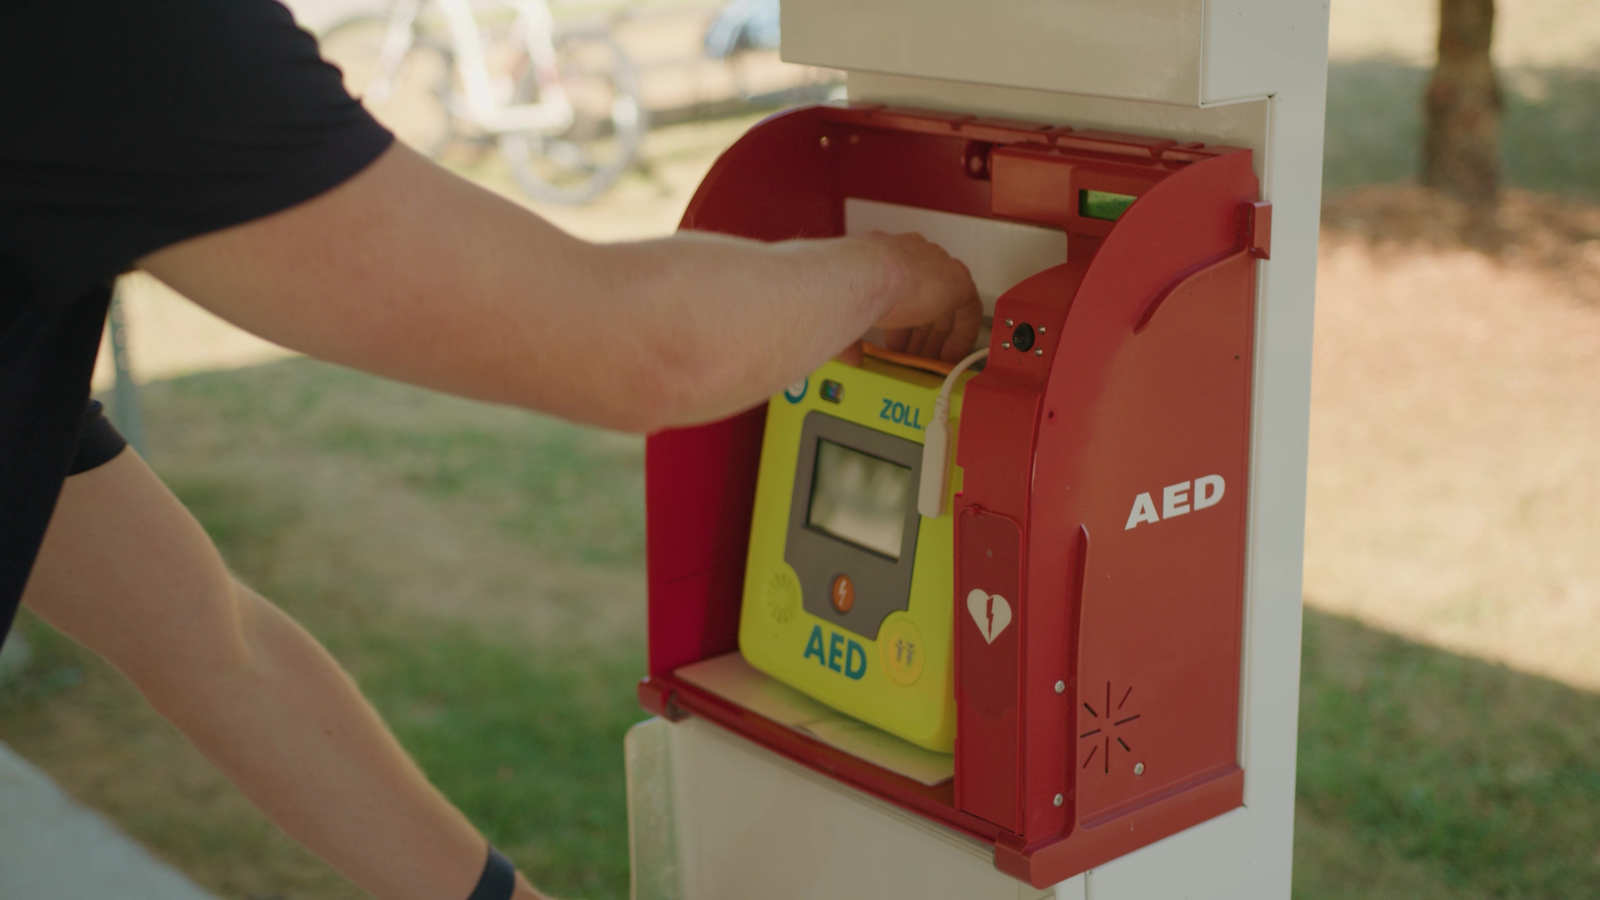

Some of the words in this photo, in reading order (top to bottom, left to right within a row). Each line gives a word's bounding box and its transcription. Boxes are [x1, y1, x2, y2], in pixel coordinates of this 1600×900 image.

[879, 397, 921, 430] ZOLL
[1124, 474, 1226, 531] AED
[803, 623, 867, 681] AED
